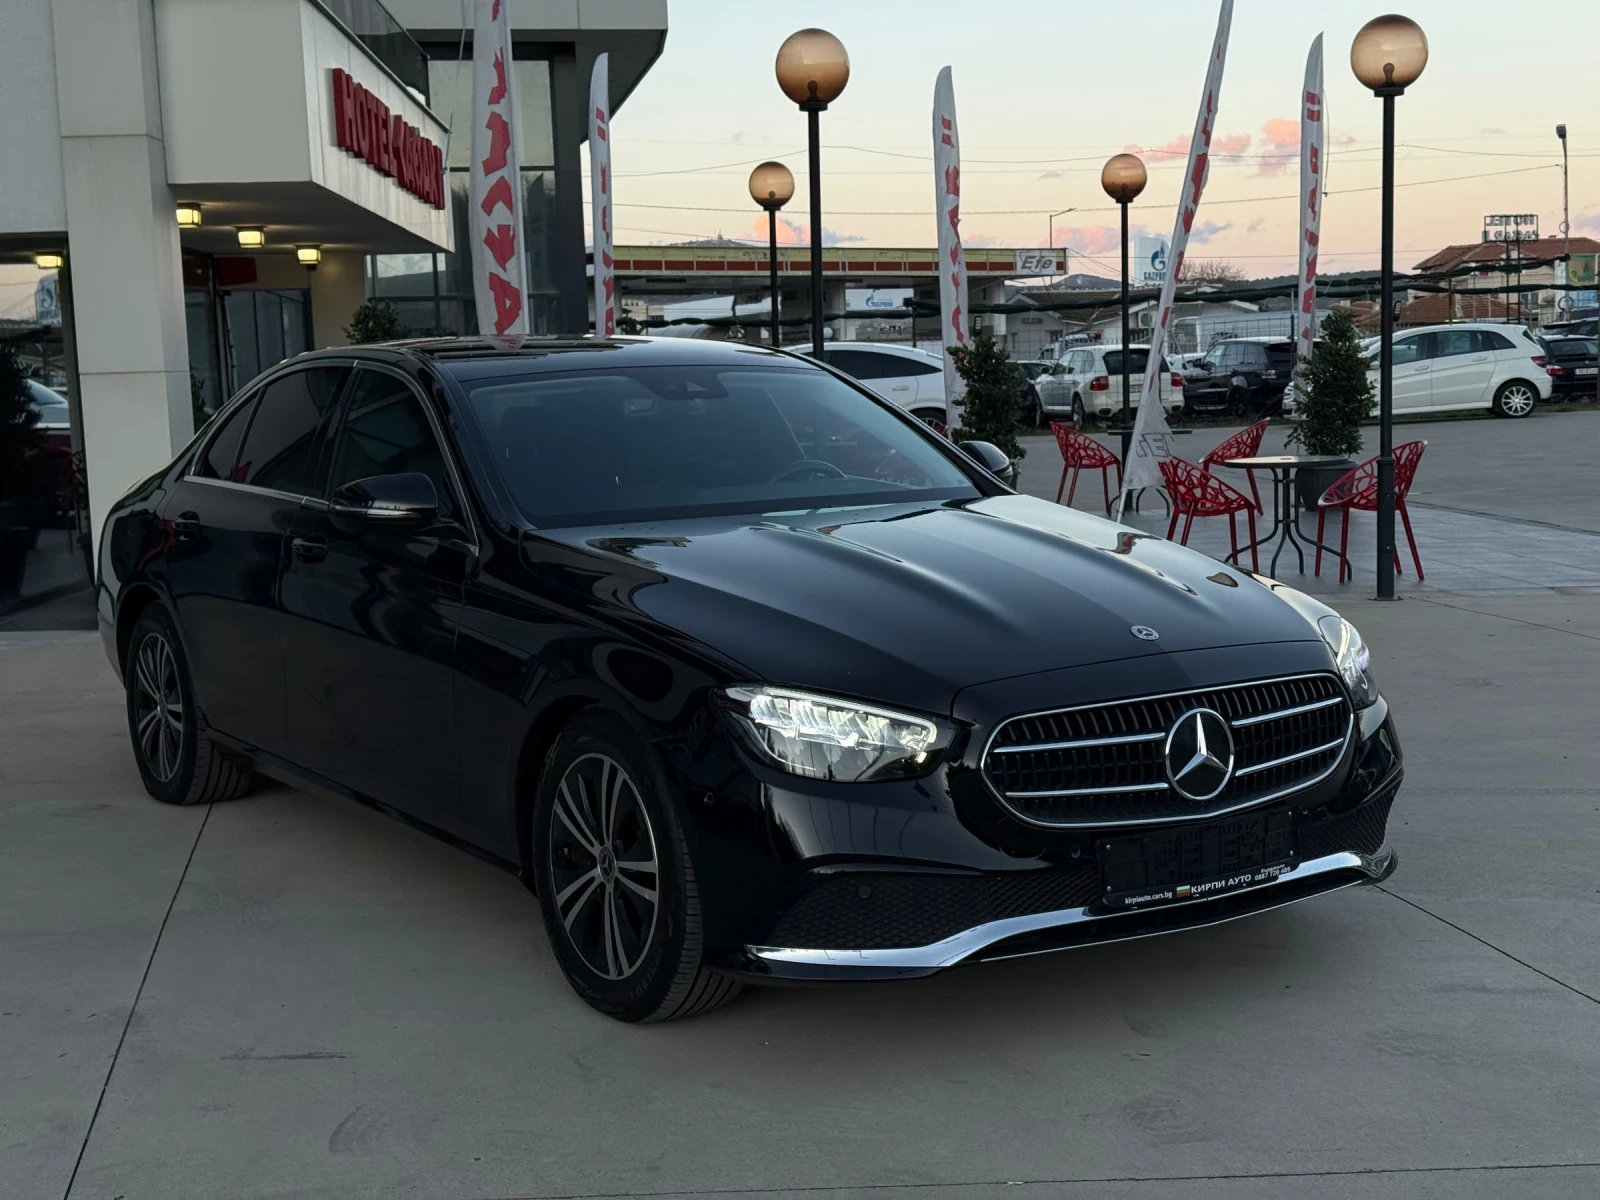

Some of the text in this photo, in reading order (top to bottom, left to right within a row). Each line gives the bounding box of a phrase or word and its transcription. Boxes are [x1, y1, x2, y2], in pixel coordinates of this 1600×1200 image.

[332, 68, 398, 178] HOTEL
[1021, 255, 1053, 270] Efe
[1191, 874, 1252, 894] КИРПИ АУТО
[1124, 891, 1173, 905] kirpiauto.cars.bg
